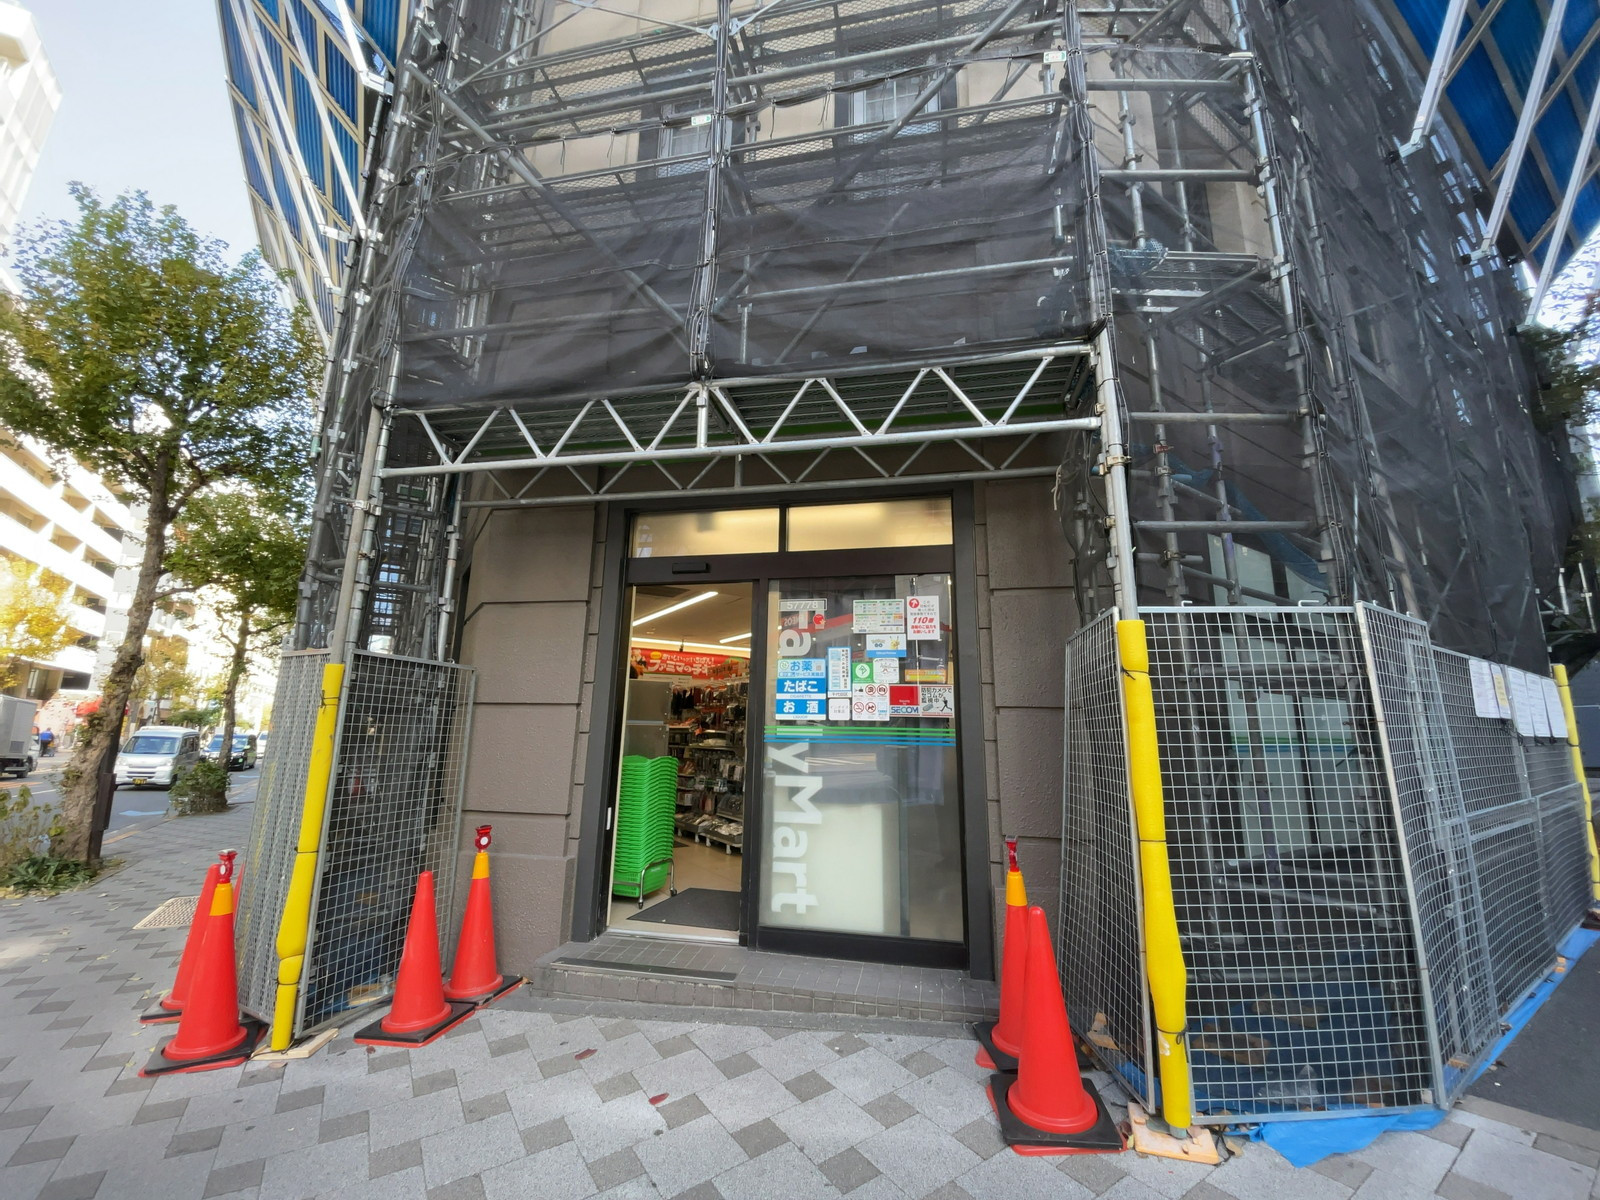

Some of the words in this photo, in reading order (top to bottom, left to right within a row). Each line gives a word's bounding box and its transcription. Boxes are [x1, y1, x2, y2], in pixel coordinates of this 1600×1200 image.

[787, 601, 818, 610] 57778
[790, 660, 813, 671] お薬
[783, 680, 818, 692] たばこ
[891, 706, 919, 714] SECOM
